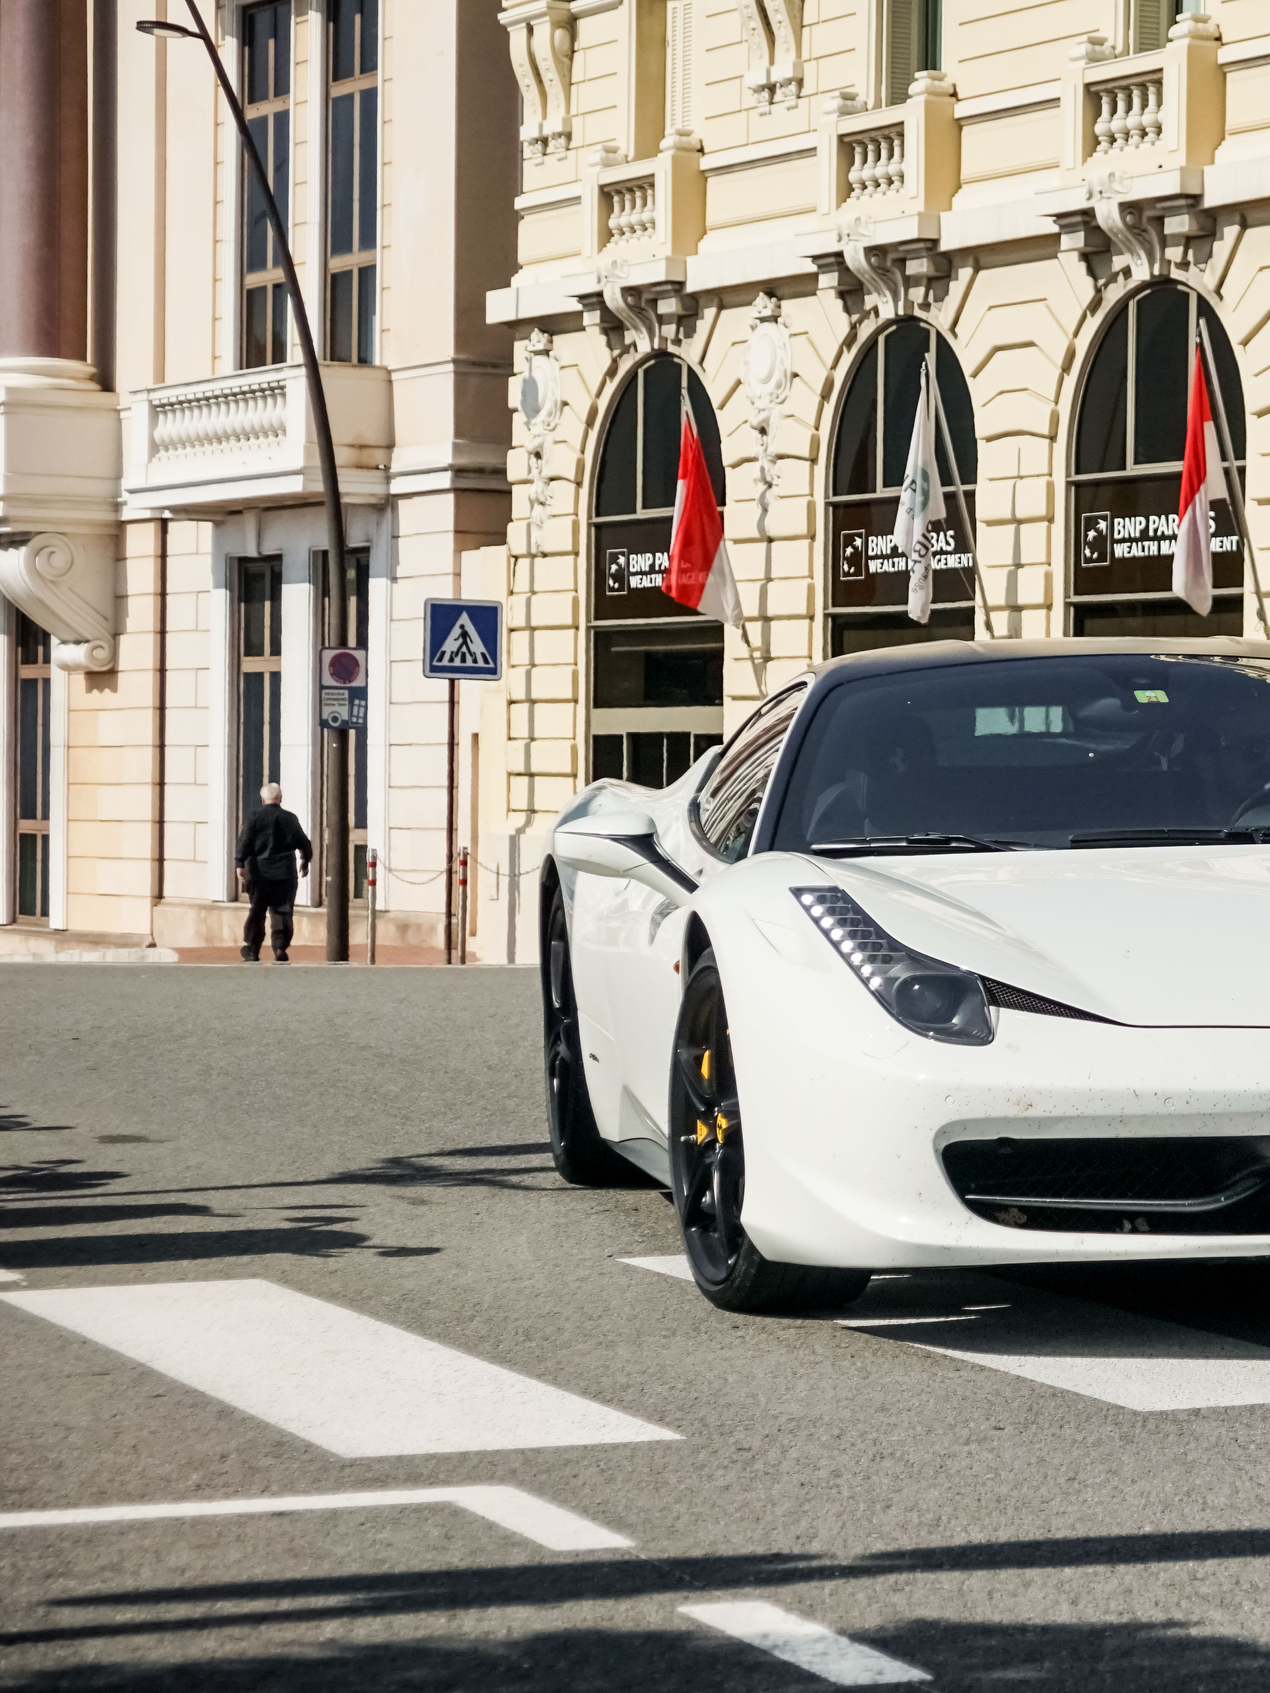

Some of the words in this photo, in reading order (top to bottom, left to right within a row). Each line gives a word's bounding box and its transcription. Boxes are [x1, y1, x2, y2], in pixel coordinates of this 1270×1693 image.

[1113, 516, 1146, 540] BNP
[868, 535, 896, 557] BNP
[1113, 540, 1158, 559] WEALTH
[629, 553, 653, 573] BNP
[868, 557, 906, 574] WEALTH
[629, 573, 662, 589] WEALTH
